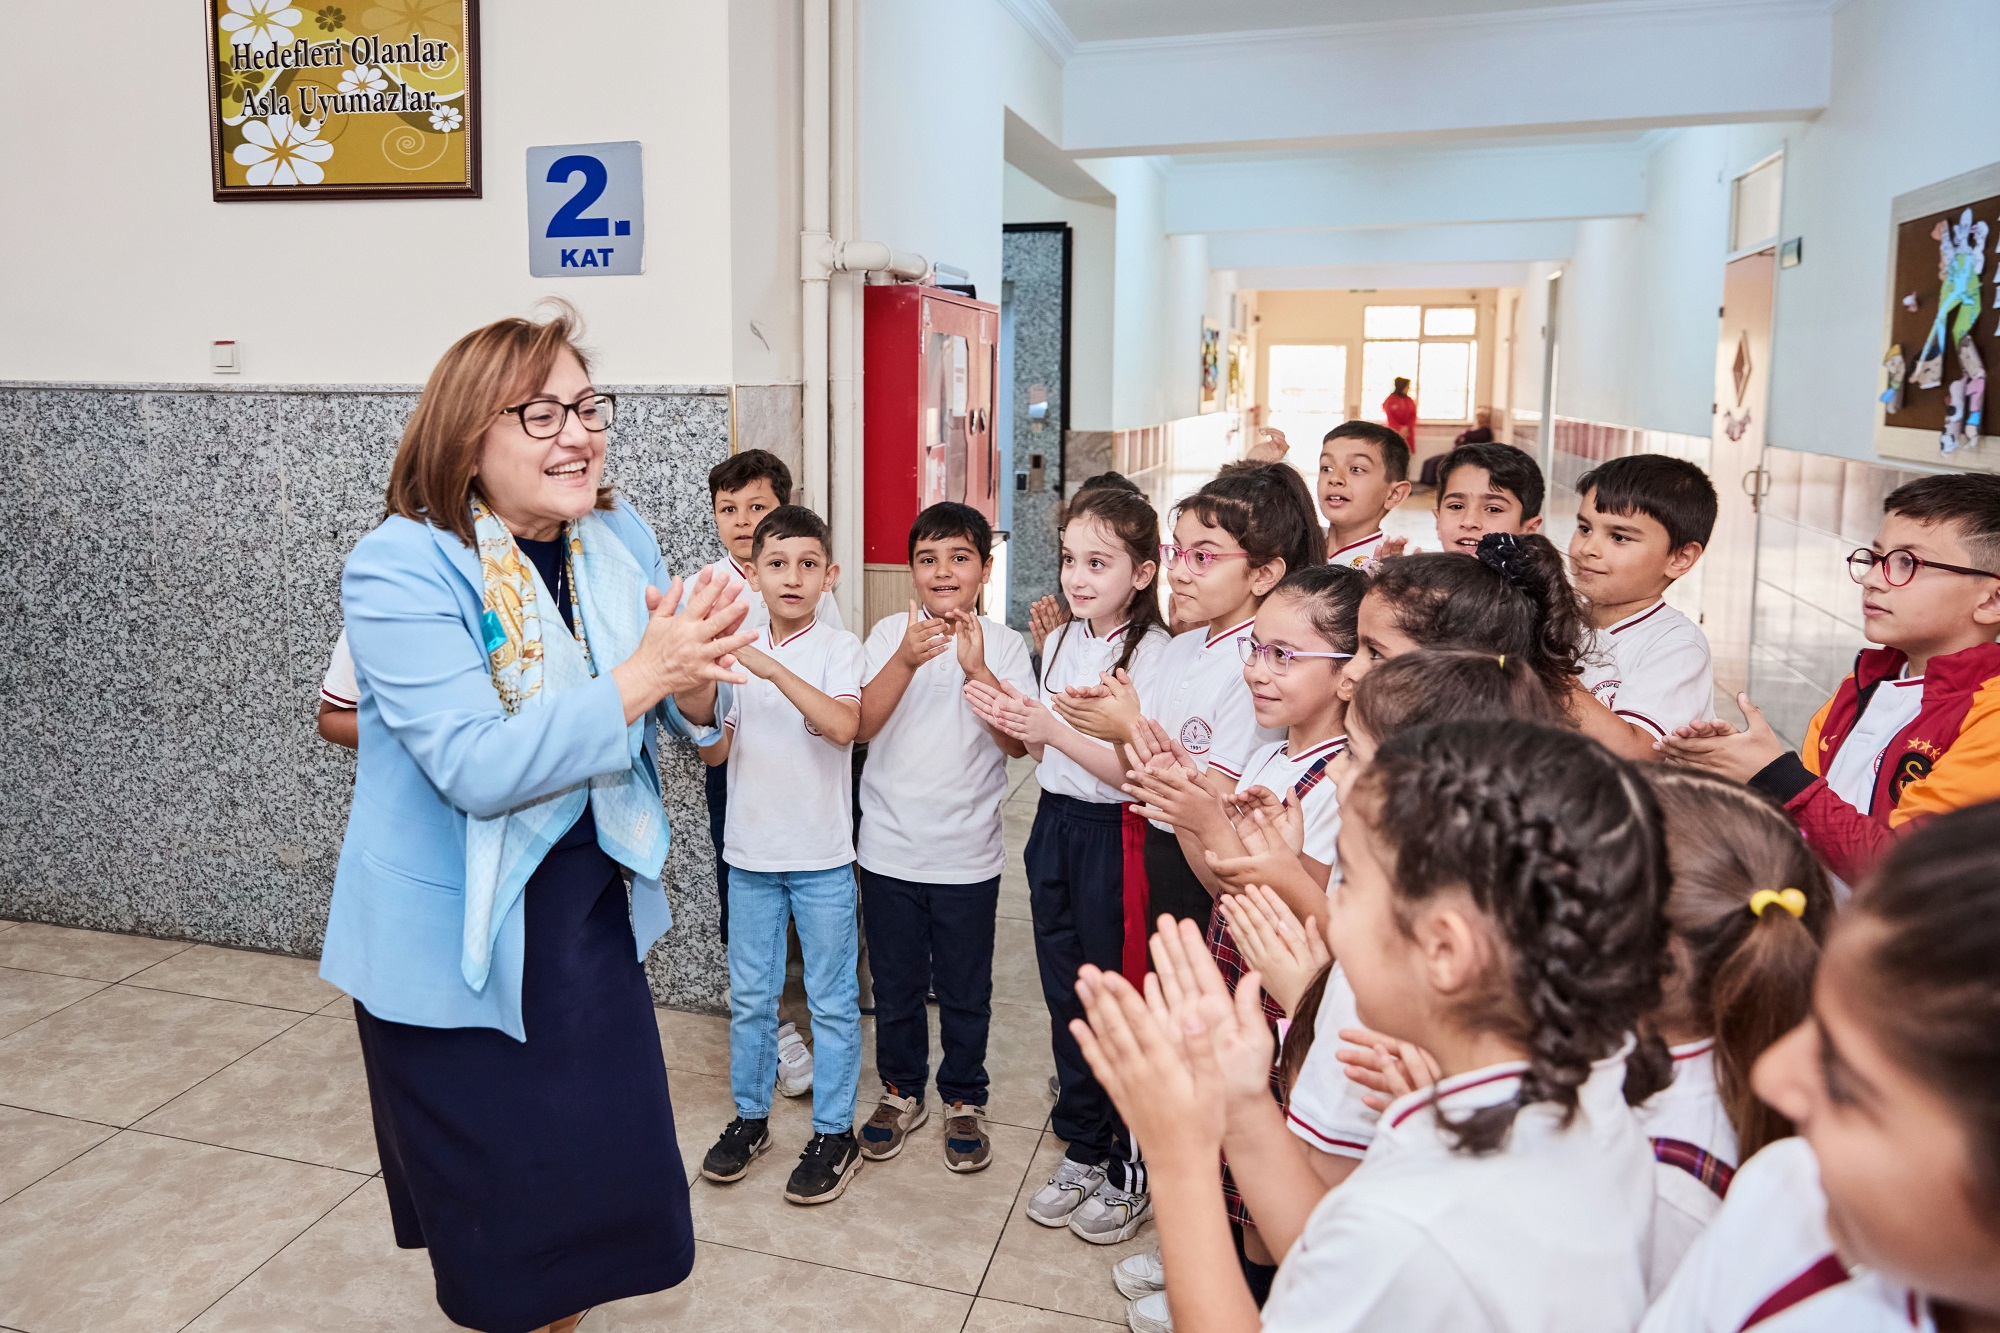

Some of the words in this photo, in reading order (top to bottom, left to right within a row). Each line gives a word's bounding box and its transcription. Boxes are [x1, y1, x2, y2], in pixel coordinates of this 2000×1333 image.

[232, 38, 343, 70] Hedefleri
[351, 34, 449, 66] Olanlar
[241, 87, 291, 117] Asla
[299, 83, 441, 124] Uyumazlar.
[546, 155, 631, 238] 2.
[561, 248, 614, 267] KAT
